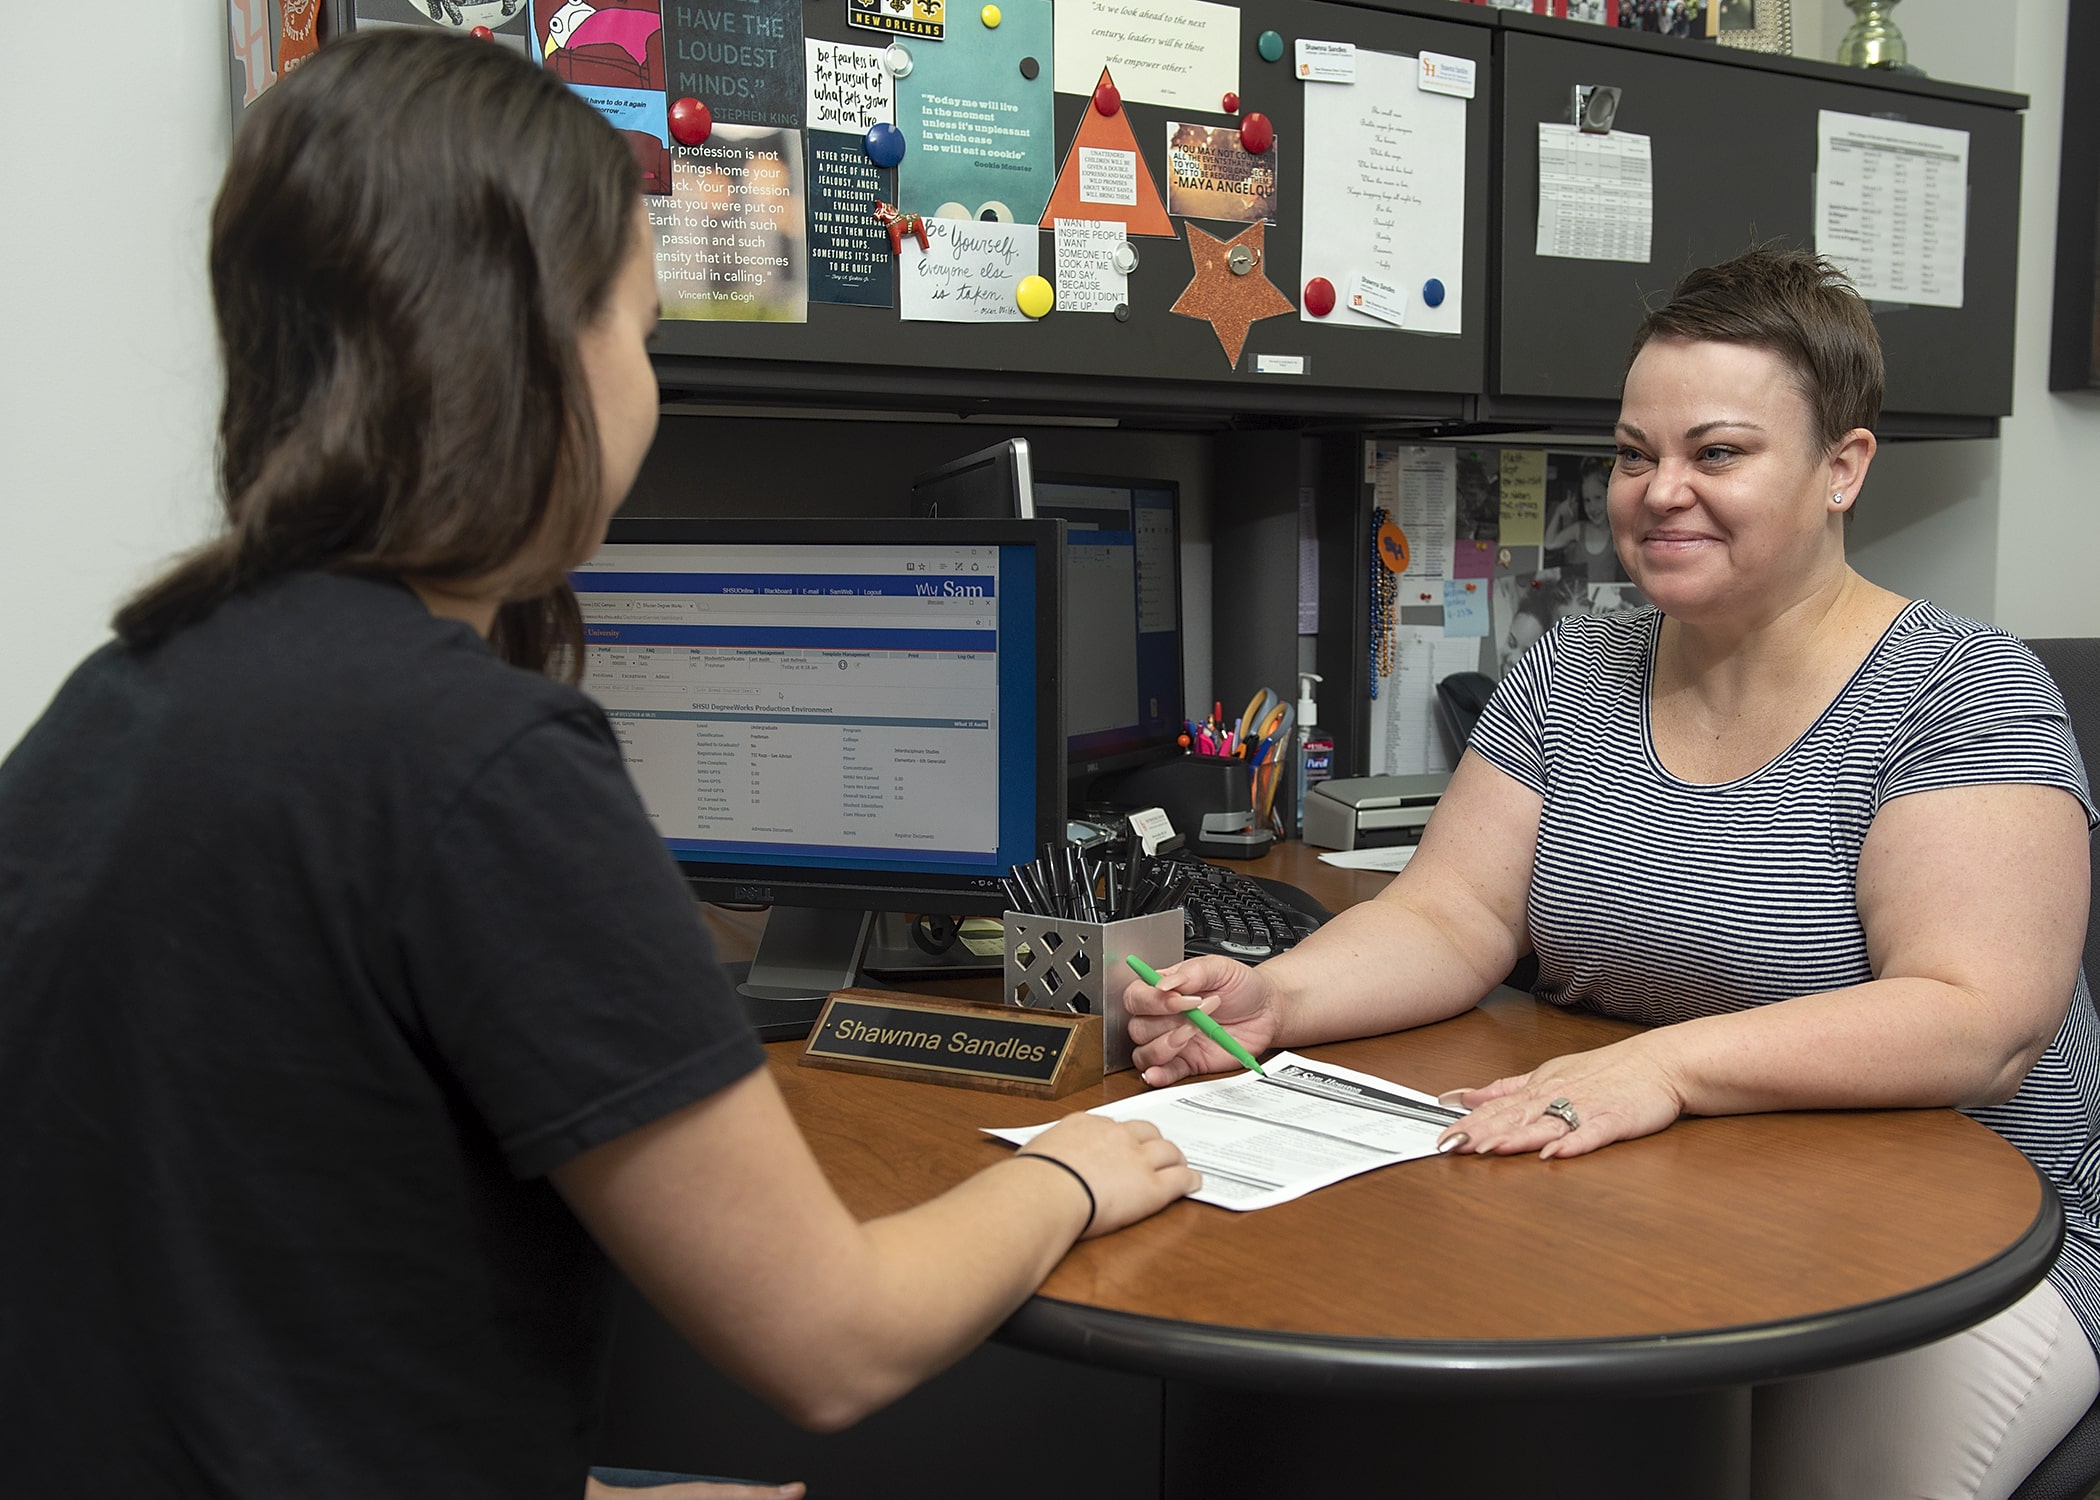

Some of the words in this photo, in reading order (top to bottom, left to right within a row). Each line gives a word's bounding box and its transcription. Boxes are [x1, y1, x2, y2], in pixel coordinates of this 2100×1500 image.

[677, 7, 736, 33] HAVE
[742, 14, 784, 38] THE
[856, 13, 881, 26] NEW
[885, 18, 940, 36] ORLEANS
[1107, 6, 1120, 14] we
[1121, 6, 1137, 17] look
[1139, 9, 1165, 21] ahead
[1164, 14, 1173, 23] to
[1174, 15, 1187, 25] the
[1188, 20, 1206, 28] next
[1091, 28, 1126, 41] century,
[1127, 32, 1156, 44] leaders
[1158, 38, 1174, 47] will
[1174, 39, 1183, 49] be
[1184, 41, 1206, 52] those
[679, 39, 778, 68] LOUDEST
[817, 47, 830, 63] be
[831, 45, 868, 70] fearless
[869, 54, 881, 70] in
[1106, 54, 1123, 64] who
[1124, 58, 1161, 69] empower
[814, 64, 833, 82] the
[835, 70, 870, 90] pursuit
[872, 73, 883, 93] of
[590, 97, 605, 105] have
[628, 101, 647, 109] again
[814, 82, 844, 109] what
[864, 94, 889, 109] your
[922, 105, 933, 115] in
[934, 106, 952, 117] the
[953, 111, 995, 121] moment
[962, 99, 978, 108] me
[979, 101, 999, 110] will
[1000, 102, 1019, 112] live
[713, 107, 767, 122] STEPHEN
[770, 112, 798, 125] KING
[842, 110, 856, 123] on
[857, 105, 877, 128] fire
[922, 119, 957, 130] unless
[974, 125, 1031, 137] unpleasant
[922, 130, 934, 139] in
[934, 131, 967, 143] which
[968, 136, 993, 145] case
[678, 144, 742, 159] profession
[745, 147, 755, 160] is
[758, 150, 779, 161] not
[922, 143, 940, 152] me
[940, 144, 962, 154] will
[962, 146, 979, 155] eat
[673, 160, 712, 177] brings
[715, 163, 750, 177] home
[753, 168, 781, 180] your
[819, 163, 824, 172] A
[826, 163, 848, 176] PLACE
[849, 166, 858, 176] OF
[974, 161, 1000, 170] Cookie
[1001, 163, 1032, 172] Monster
[696, 180, 724, 193] Your
[727, 183, 790, 197] profession
[1216, 180, 1273, 197] ANGELOU
[651, 196, 682, 209] what
[685, 200, 708, 212] you
[712, 202, 741, 212] were
[744, 203, 766, 216] put
[768, 204, 784, 214] on
[833, 201, 867, 213] EVALUATE
[648, 212, 681, 227] Earth
[684, 216, 698, 227] to
[701, 215, 718, 228] do
[721, 216, 747, 229] with
[750, 219, 778, 231] such
[925, 219, 947, 237] Be
[814, 224, 828, 234] YOU
[830, 225, 842, 235] LET
[845, 226, 863, 237] THEM
[866, 228, 887, 239] LEAVE
[1059, 229, 1090, 239] INSPIRE
[662, 233, 708, 247] passion
[712, 234, 735, 247] and
[738, 235, 766, 248] such
[831, 238, 849, 248] YOUR
[1063, 239, 1087, 247] WANT
[695, 250, 720, 264] that
[722, 251, 732, 264] it
[735, 252, 789, 267] becomes
[812, 248, 853, 260] SOMETIMES
[855, 251, 870, 262] IT'S
[871, 253, 888, 263] BEST
[1059, 248, 1100, 259] SOMEONE
[1102, 250, 1113, 260] TO
[829, 261, 838, 271] TO
[841, 262, 850, 272] BE
[851, 263, 872, 274] QUIET
[918, 258, 973, 286] Everyone
[980, 262, 1013, 279] else
[1059, 259, 1082, 268] LOOK
[1083, 260, 1094, 269] AT
[1097, 261, 1109, 270] ME
[658, 268, 706, 282] spiritual
[710, 270, 721, 281] in
[1059, 269, 1077, 279] AND
[678, 290, 711, 301] Vincent
[712, 291, 729, 300] Van
[730, 291, 755, 303] Gogh
[931, 284, 950, 299] is
[1059, 290, 1071, 299] OF
[1073, 291, 1091, 300] YOU
[1098, 292, 1125, 301] DIDN'T
[1059, 301, 1078, 310] GIVE
[722, 587, 754, 595] SHSUOnline
[764, 587, 793, 595] Blackboard
[863, 589, 882, 597] Logout
[915, 582, 938, 597] My
[943, 580, 984, 597] Sam
[588, 629, 620, 638] University
[692, 703, 710, 711] SHSU
[711, 703, 754, 712] DegreeWorks
[834, 1018, 942, 1051] Shawnna
[947, 1031, 1046, 1062] Sandles
[1302, 1072, 1324, 1086] Sam
